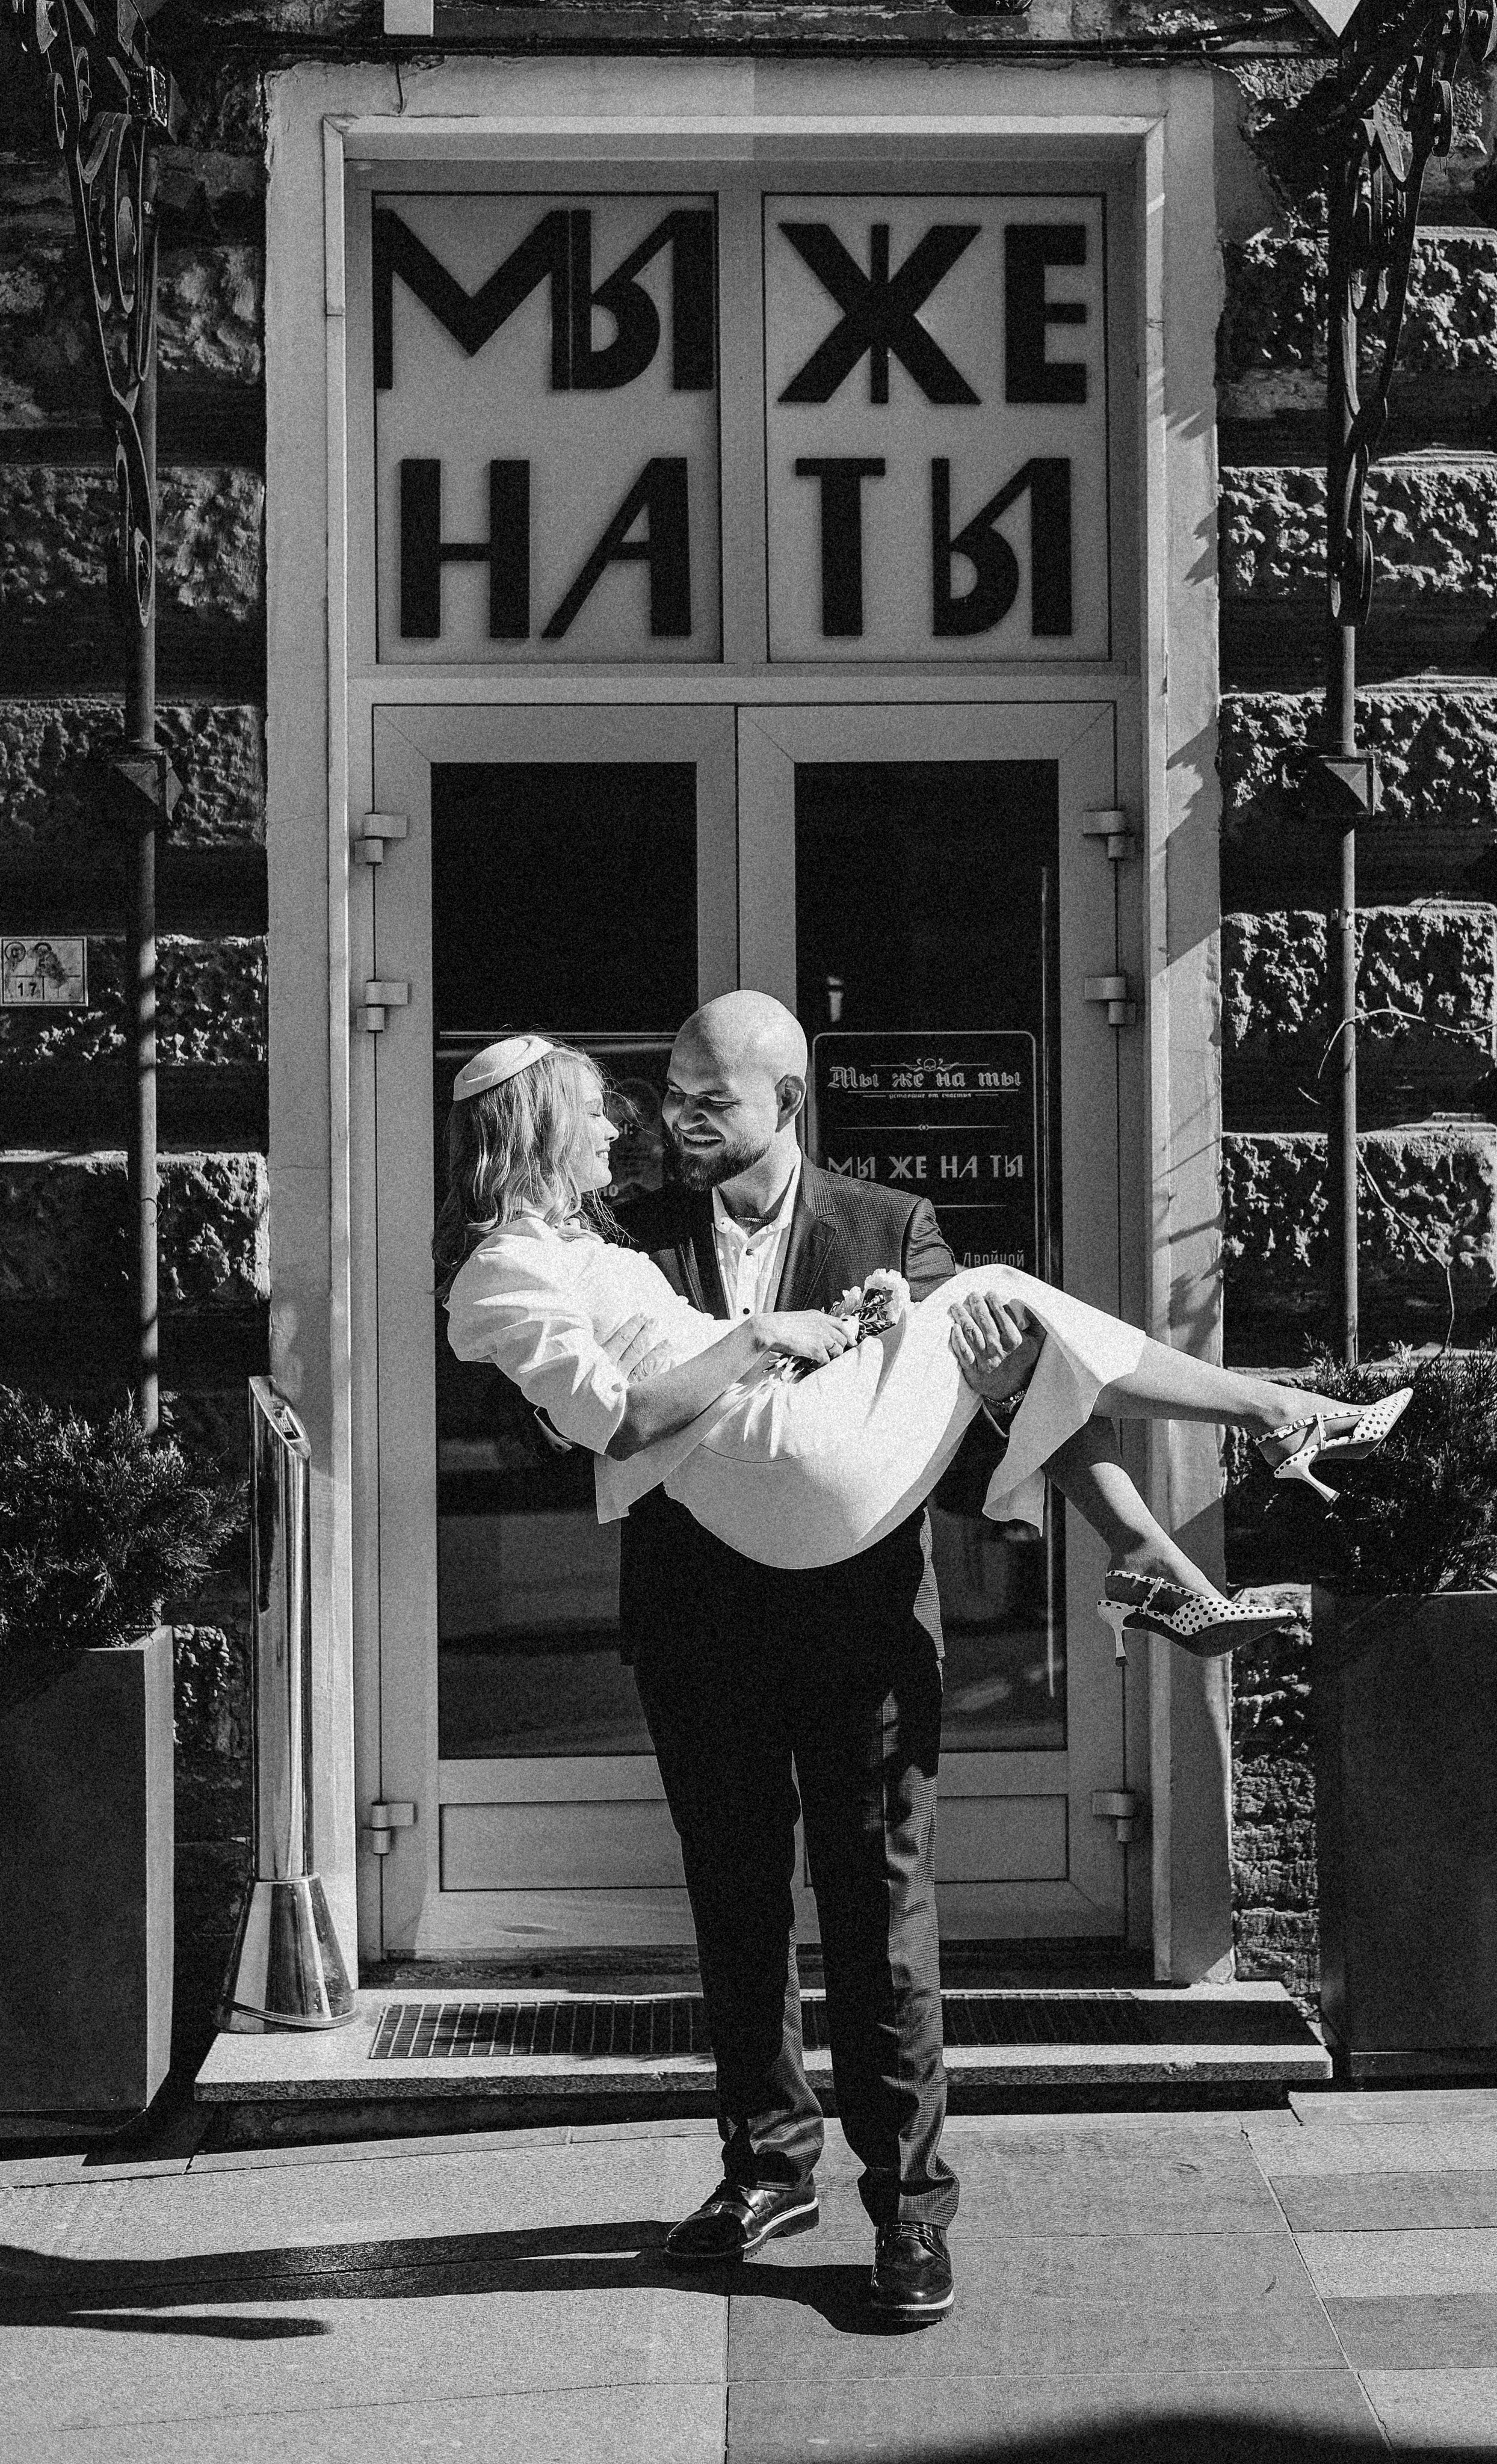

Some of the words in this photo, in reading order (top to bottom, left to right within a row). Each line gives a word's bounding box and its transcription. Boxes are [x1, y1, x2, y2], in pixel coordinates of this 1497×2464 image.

[776, 223, 1087, 405] ЖЕ
[399, 457, 692, 639] НА
[794, 457, 1073, 638] ТЫ
[17, 982, 37, 997] 17
[827, 1067, 879, 1088] Мы
[892, 1073, 924, 1087] же
[936, 1072, 965, 1087] на
[978, 1072, 1021, 1086] ты
[889, 1156, 927, 1179] ЖЕ
[940, 1155, 978, 1178] НА
[990, 1154, 1023, 1178] ТЫ
